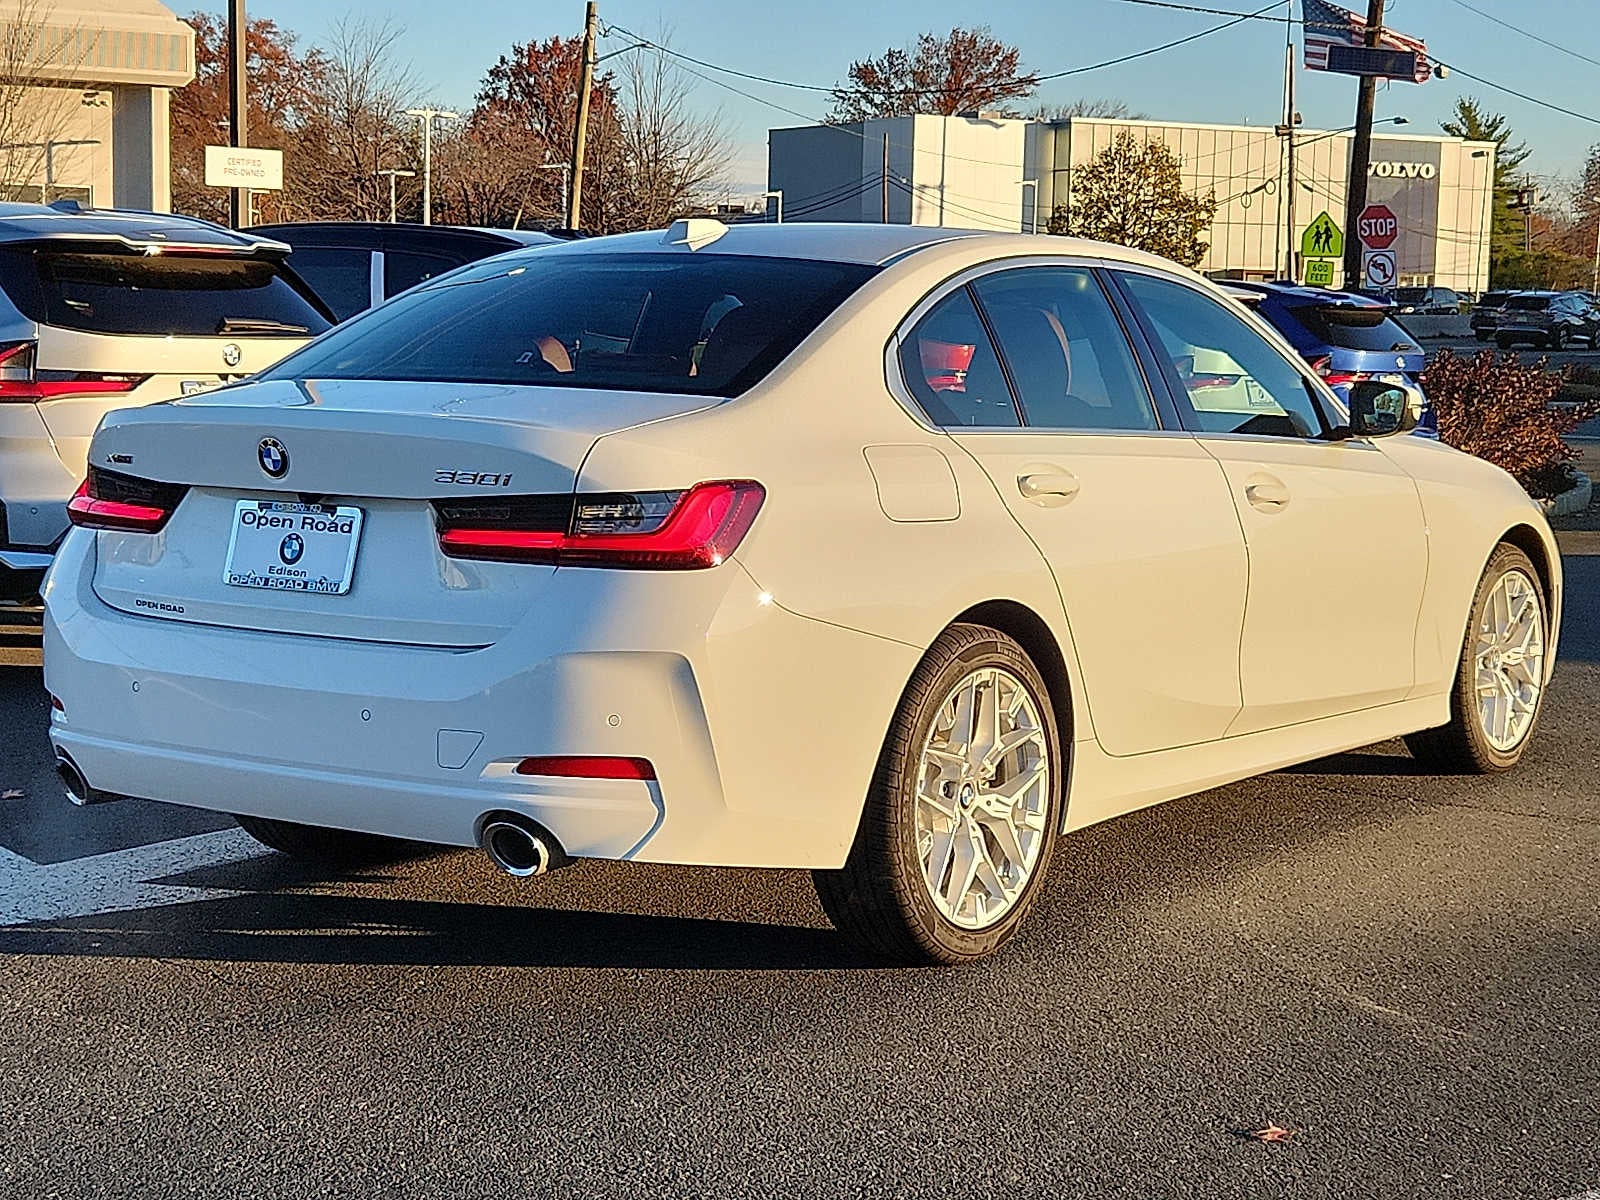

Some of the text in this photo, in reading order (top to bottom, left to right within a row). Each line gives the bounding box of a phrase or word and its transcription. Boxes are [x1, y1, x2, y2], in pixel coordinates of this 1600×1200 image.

[1368, 161, 1436, 179] VOLVO
[1361, 218, 1395, 236] STOP
[1312, 264, 1328, 272] 600
[1310, 272, 1329, 282] FEET
[434, 470, 512, 487] 330i
[241, 511, 354, 534] Open Road
[268, 565, 307, 578] Edison
[230, 574, 339, 593] OPEN ROAD BMW
[135, 599, 185, 613] OPEN ROAD
